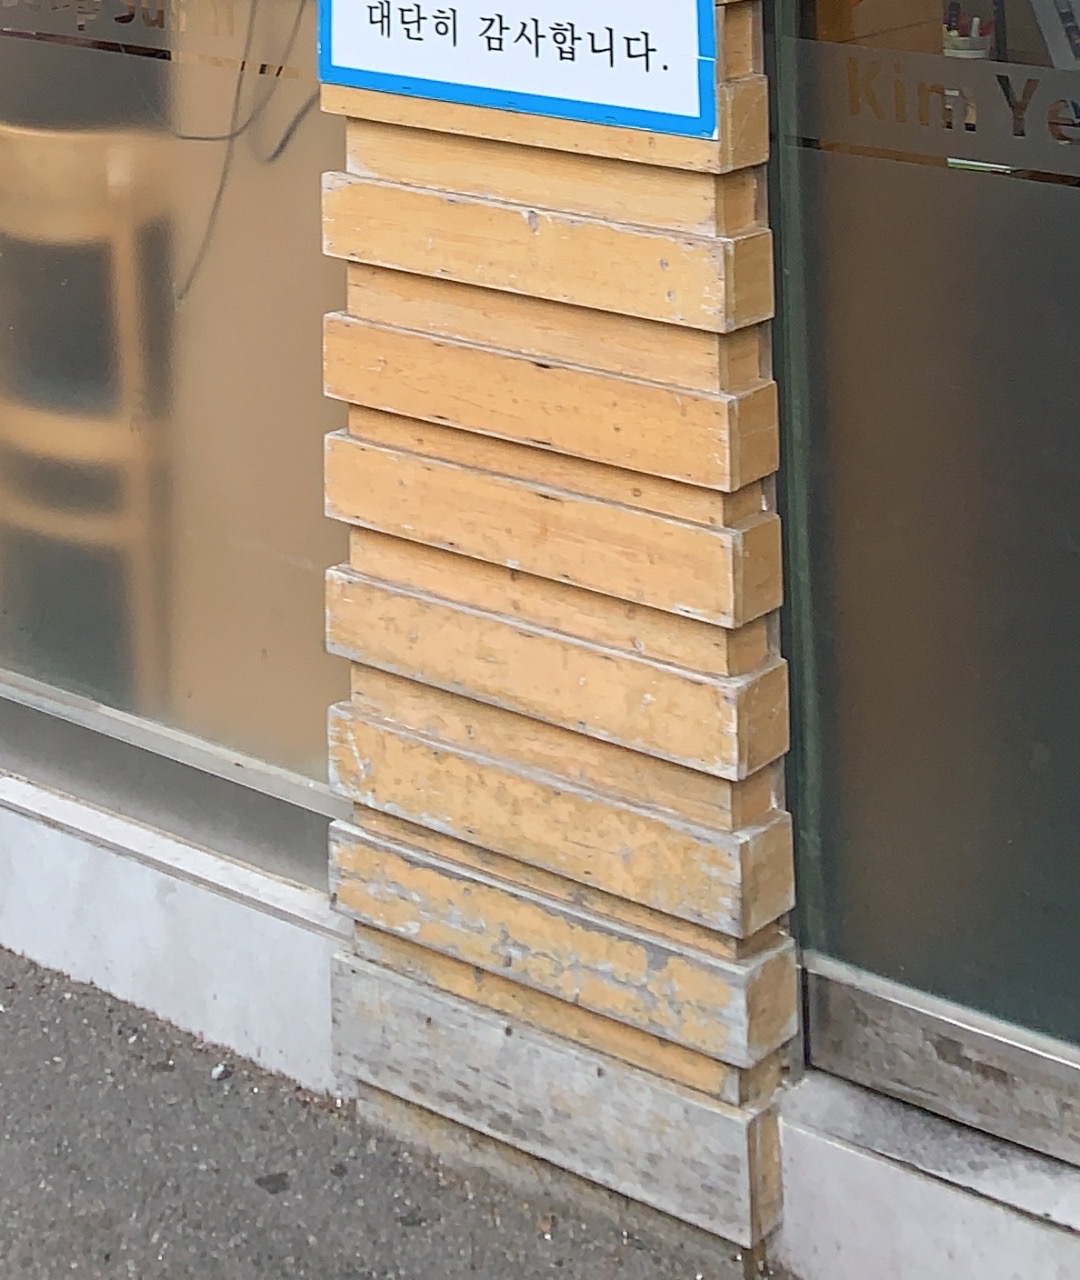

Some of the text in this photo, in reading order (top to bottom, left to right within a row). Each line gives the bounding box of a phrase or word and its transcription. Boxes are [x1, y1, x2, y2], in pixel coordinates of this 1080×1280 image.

[367, 0, 670, 73] 대단히 감사합니다.
[846, 56, 977, 132] Kim
